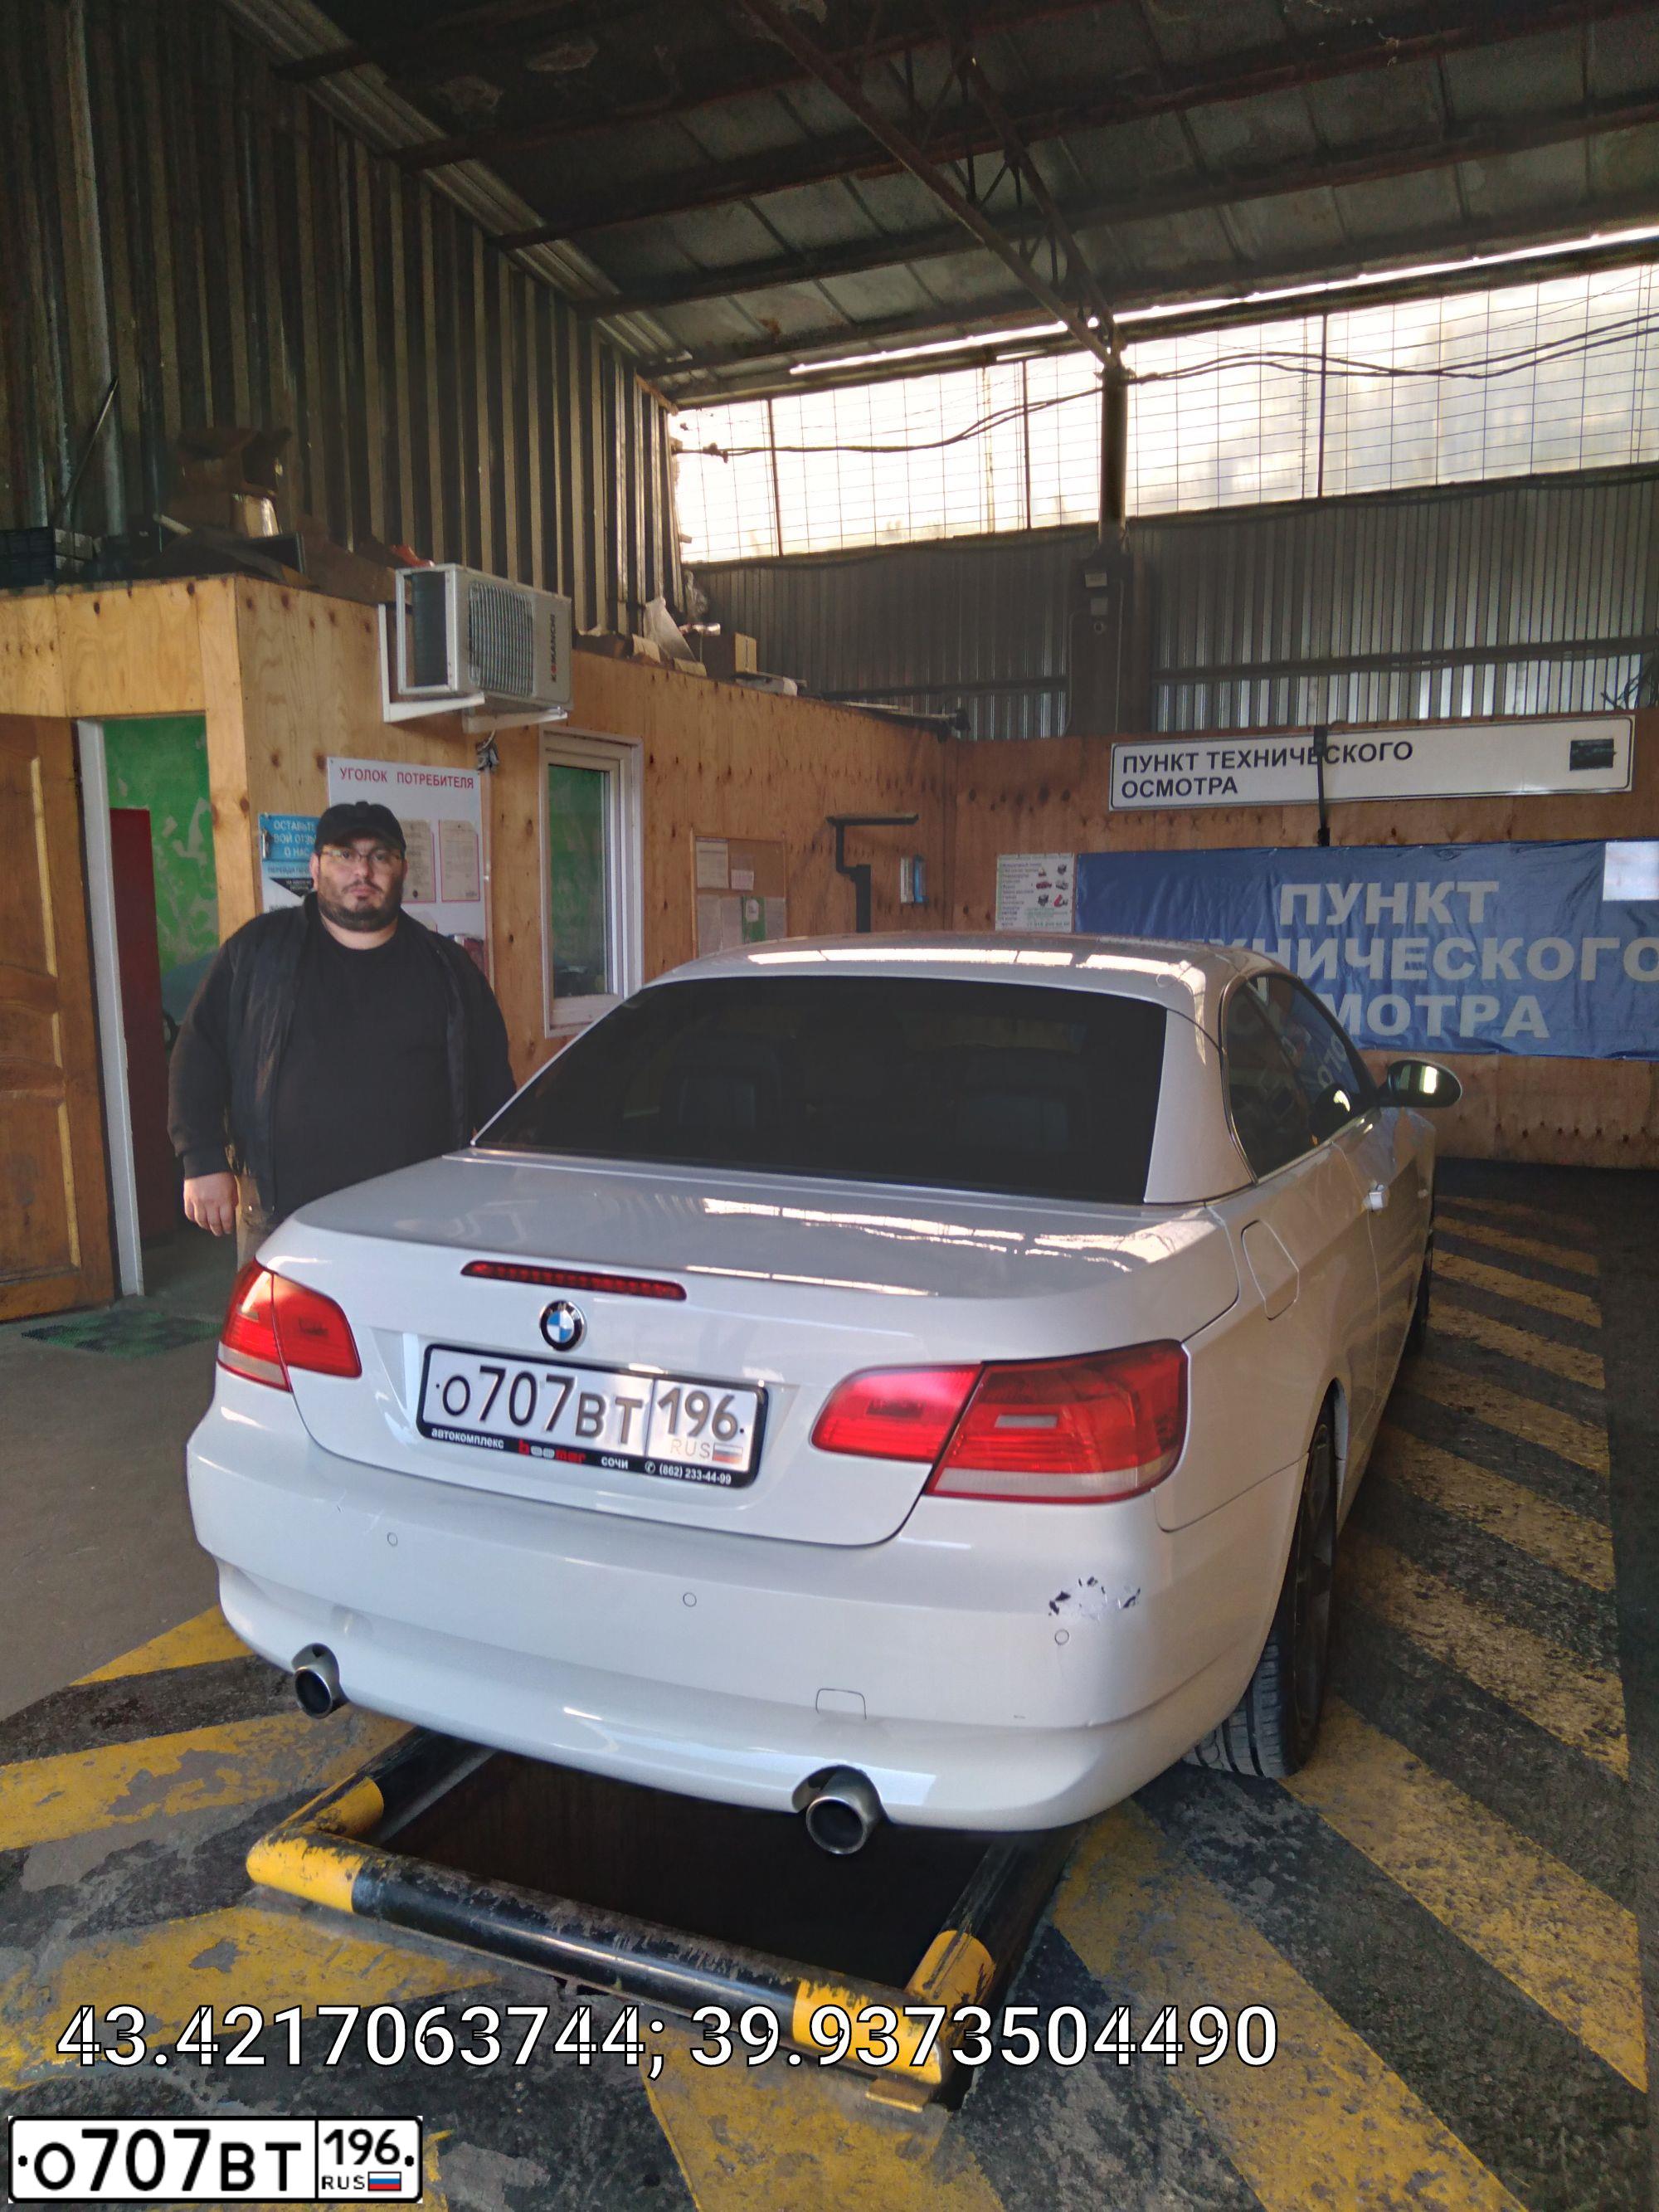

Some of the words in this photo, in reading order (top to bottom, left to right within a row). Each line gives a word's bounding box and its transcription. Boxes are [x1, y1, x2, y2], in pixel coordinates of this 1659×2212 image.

[1123, 753, 1199, 773] ПУНКТ
[1207, 741, 1413, 770] ТЕХНИЧЕСКОГО
[340, 767, 388, 782] УГОЛОК
[397, 772, 474, 788] ПОТРЕБИТЕЛЯ
[1121, 777, 1238, 798] ОСМОТРА
[1279, 881, 1499, 926] ПУНКТ
[1194, 937, 1659, 982] НИЧЕСКОГО
[1326, 994, 1550, 1039] МОТРА
[442, 1365, 645, 1445] О707ВТ
[657, 1387, 738, 1441] 196
[431, 1427, 504, 1449] автокомплекс
[669, 1438, 711, 1459] RUS
[659, 1464, 683, 1479] (862)
[685, 1468, 732, 1486] 233-44-99
